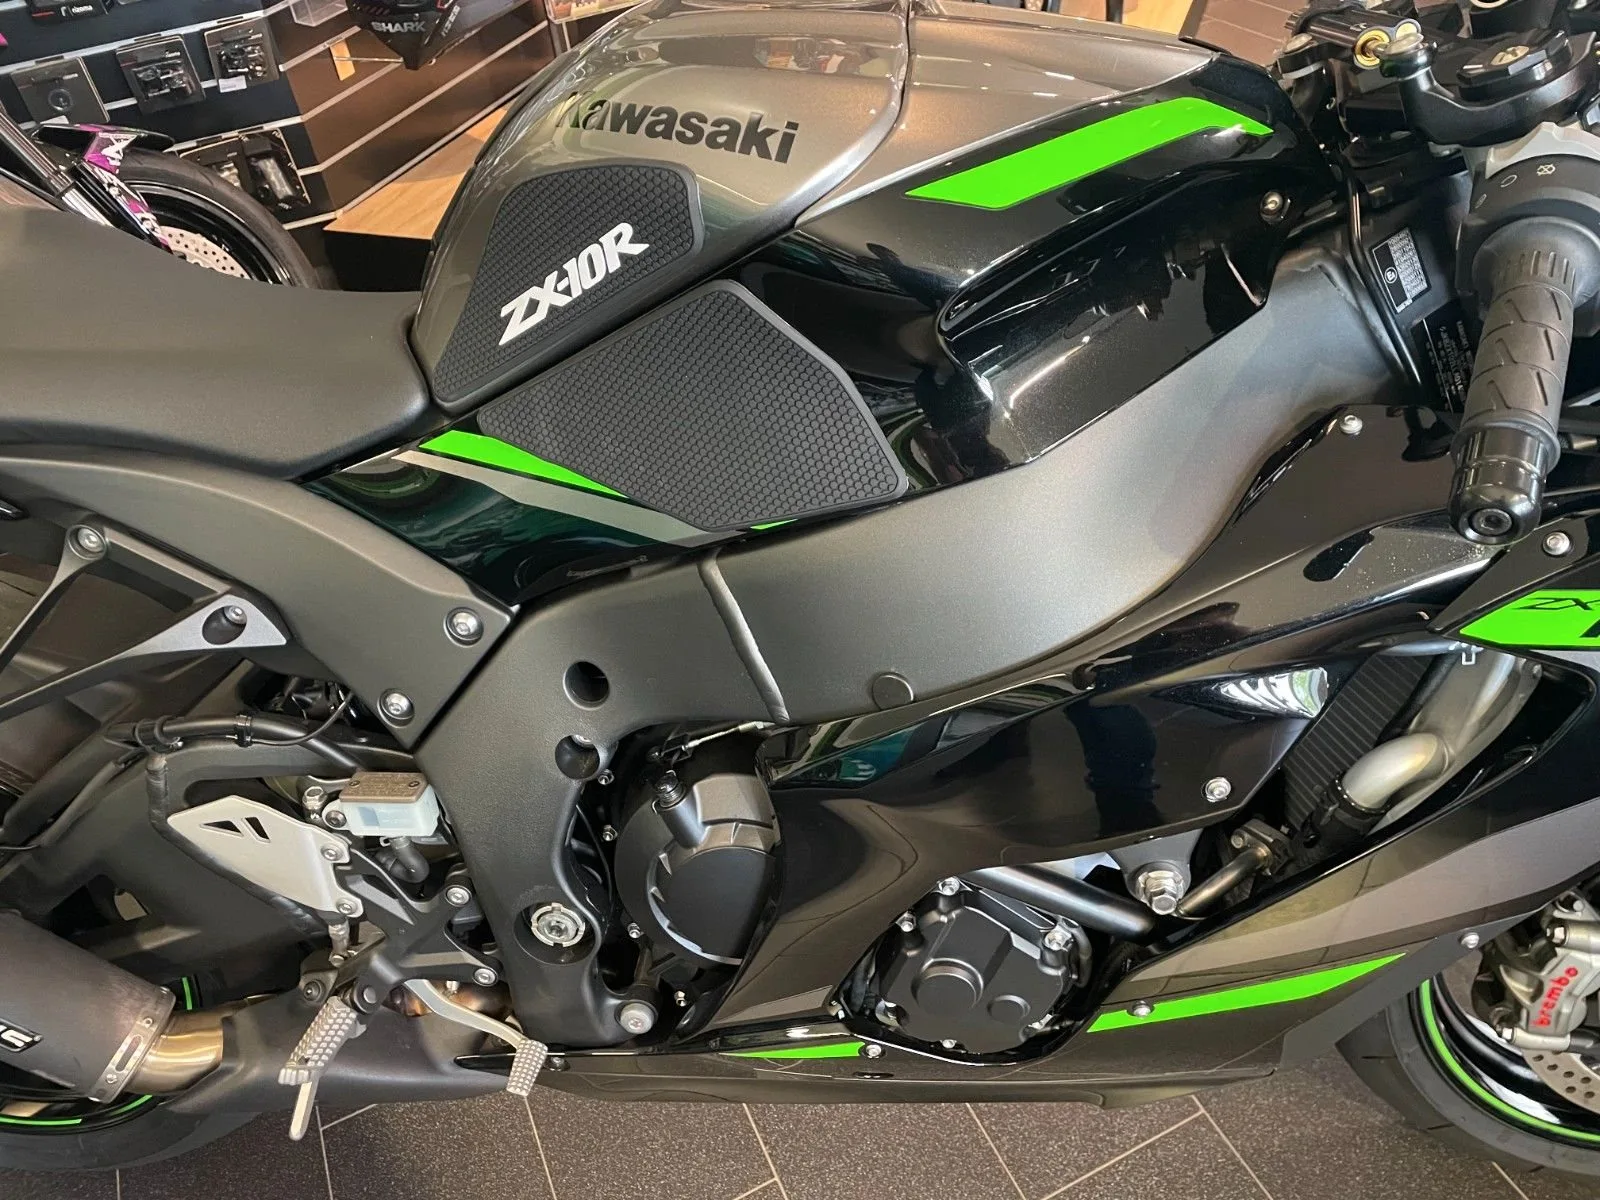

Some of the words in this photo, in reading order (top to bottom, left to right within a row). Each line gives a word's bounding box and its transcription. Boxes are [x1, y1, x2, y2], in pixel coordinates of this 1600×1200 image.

[371, 21, 426, 33] SHARK
[499, 222, 650, 346] ZX-10R
[1532, 966, 1579, 1027] brembo
